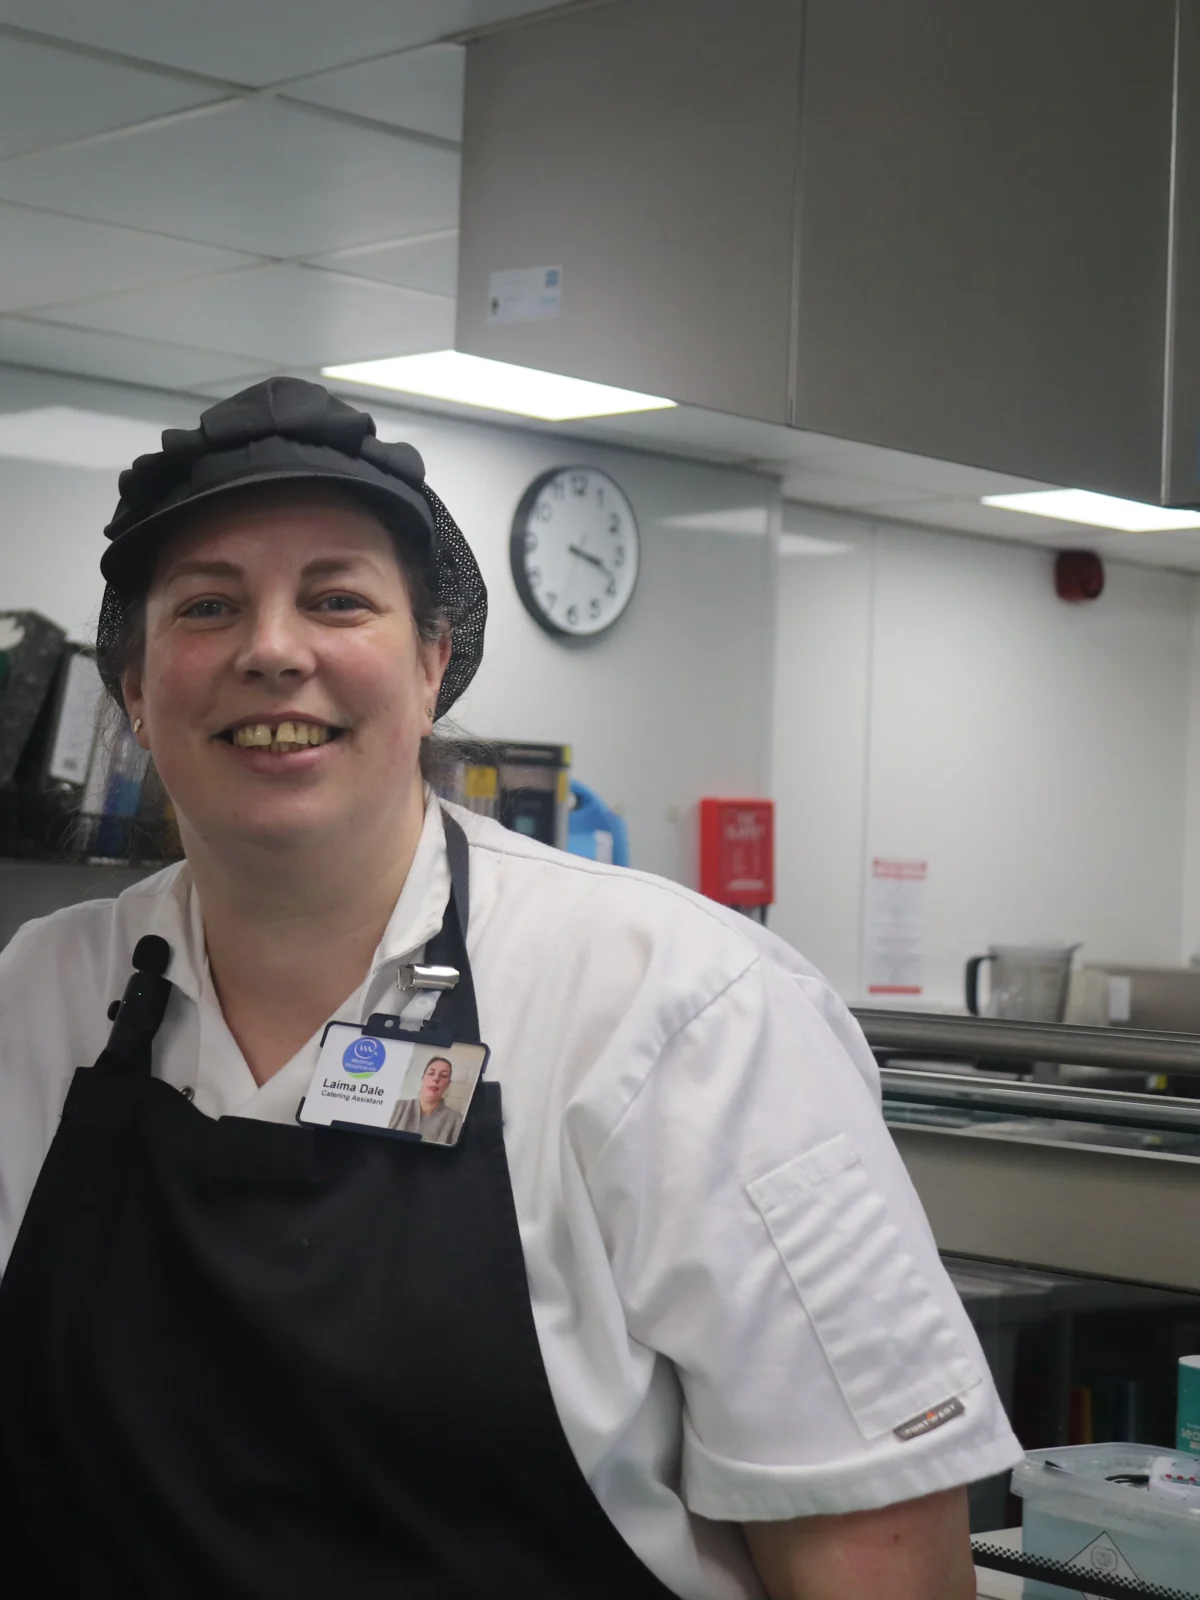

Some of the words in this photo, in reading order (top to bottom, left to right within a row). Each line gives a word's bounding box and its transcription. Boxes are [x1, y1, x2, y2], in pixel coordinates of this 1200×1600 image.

[571, 475, 588, 496] 12
[597, 487, 604, 508] 1
[536, 502, 552, 523] 10
[608, 512, 621, 535] 2
[614, 545, 625, 567] 3
[605, 577, 617, 597] 4
[546, 592, 557, 610] 7
[589, 599, 600, 620] 5
[567, 605, 578, 625] 6
[321, 1090, 350, 1102] Catering
[351, 1094, 384, 1105] Assistant
[323, 1078, 357, 1092] Laima
[359, 1083, 385, 1096] Dale
